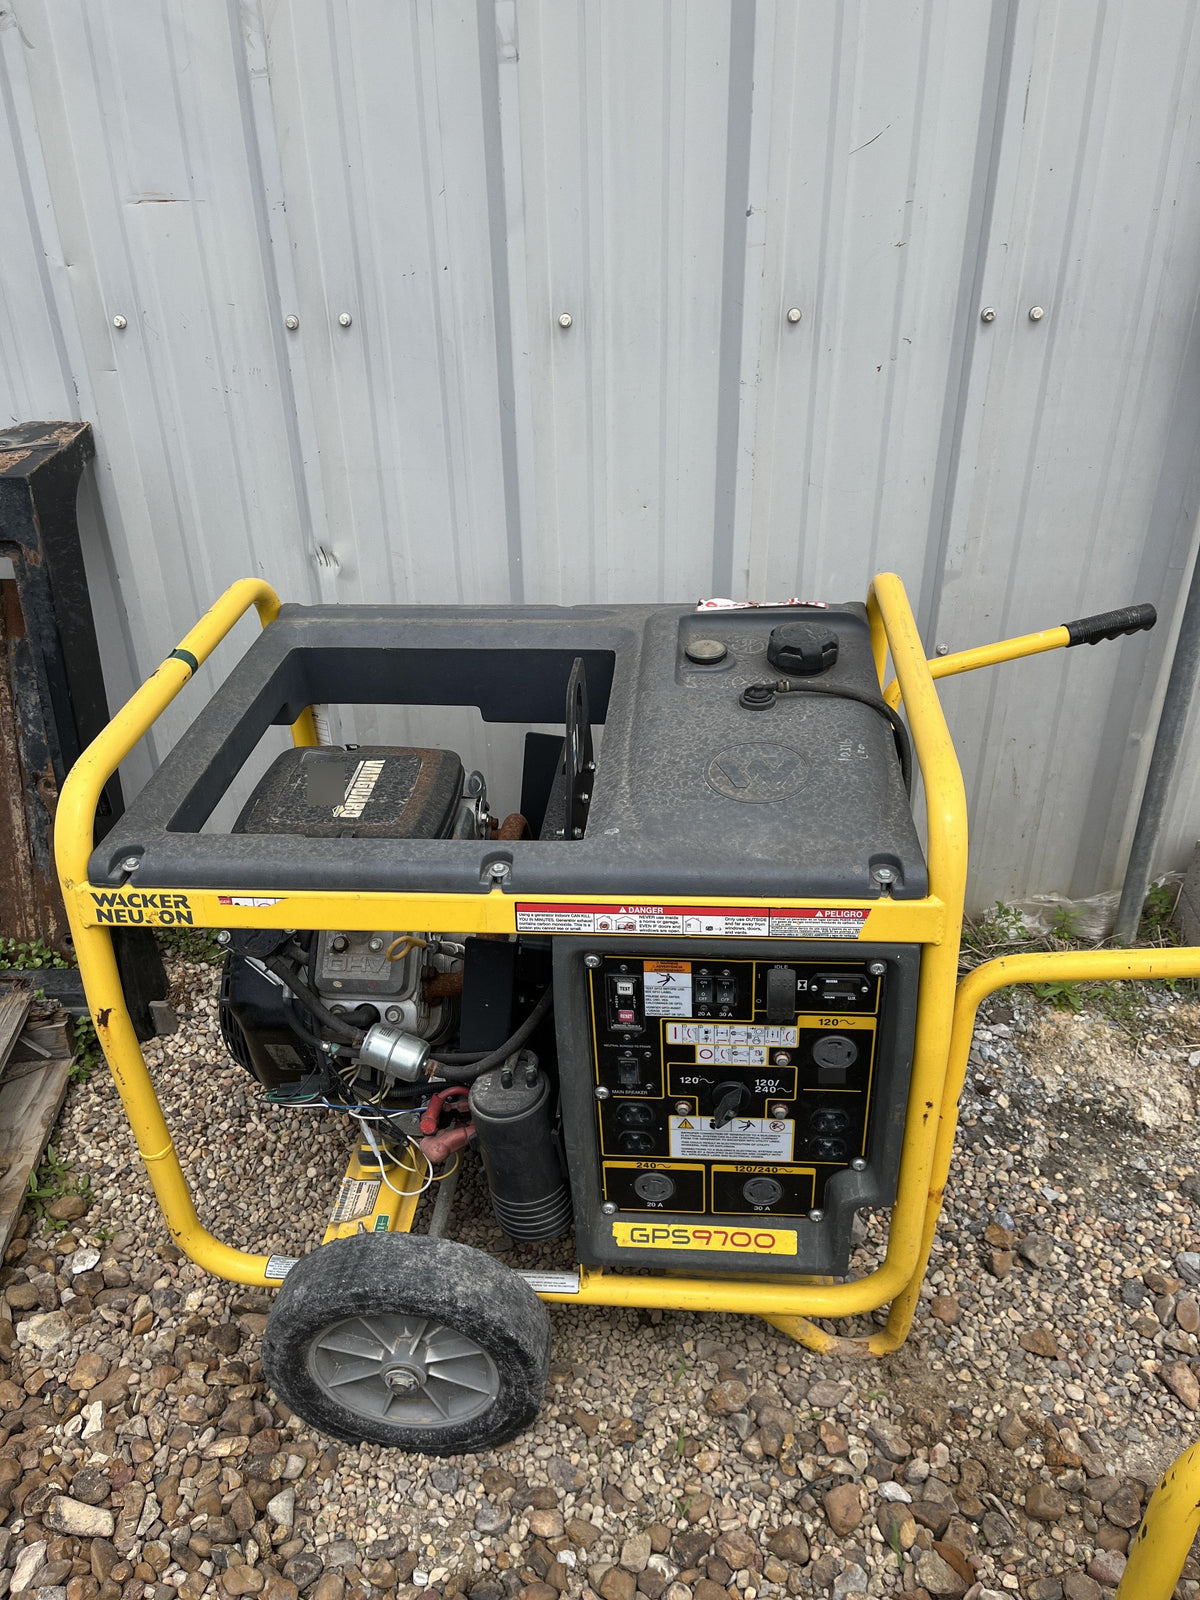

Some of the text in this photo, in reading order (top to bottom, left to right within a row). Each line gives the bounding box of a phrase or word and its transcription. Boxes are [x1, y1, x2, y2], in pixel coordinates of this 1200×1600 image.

[340, 760, 386, 817] VANGUARD
[90, 893, 191, 909] WACKER
[96, 909, 193, 925] NEUON
[824, 910, 863, 918] PELIGRO
[328, 957, 386, 973] OHV
[755, 1079, 779, 1087] 120/
[734, 1165, 778, 1174] 120/240
[630, 1227, 776, 1249] GPS9700
